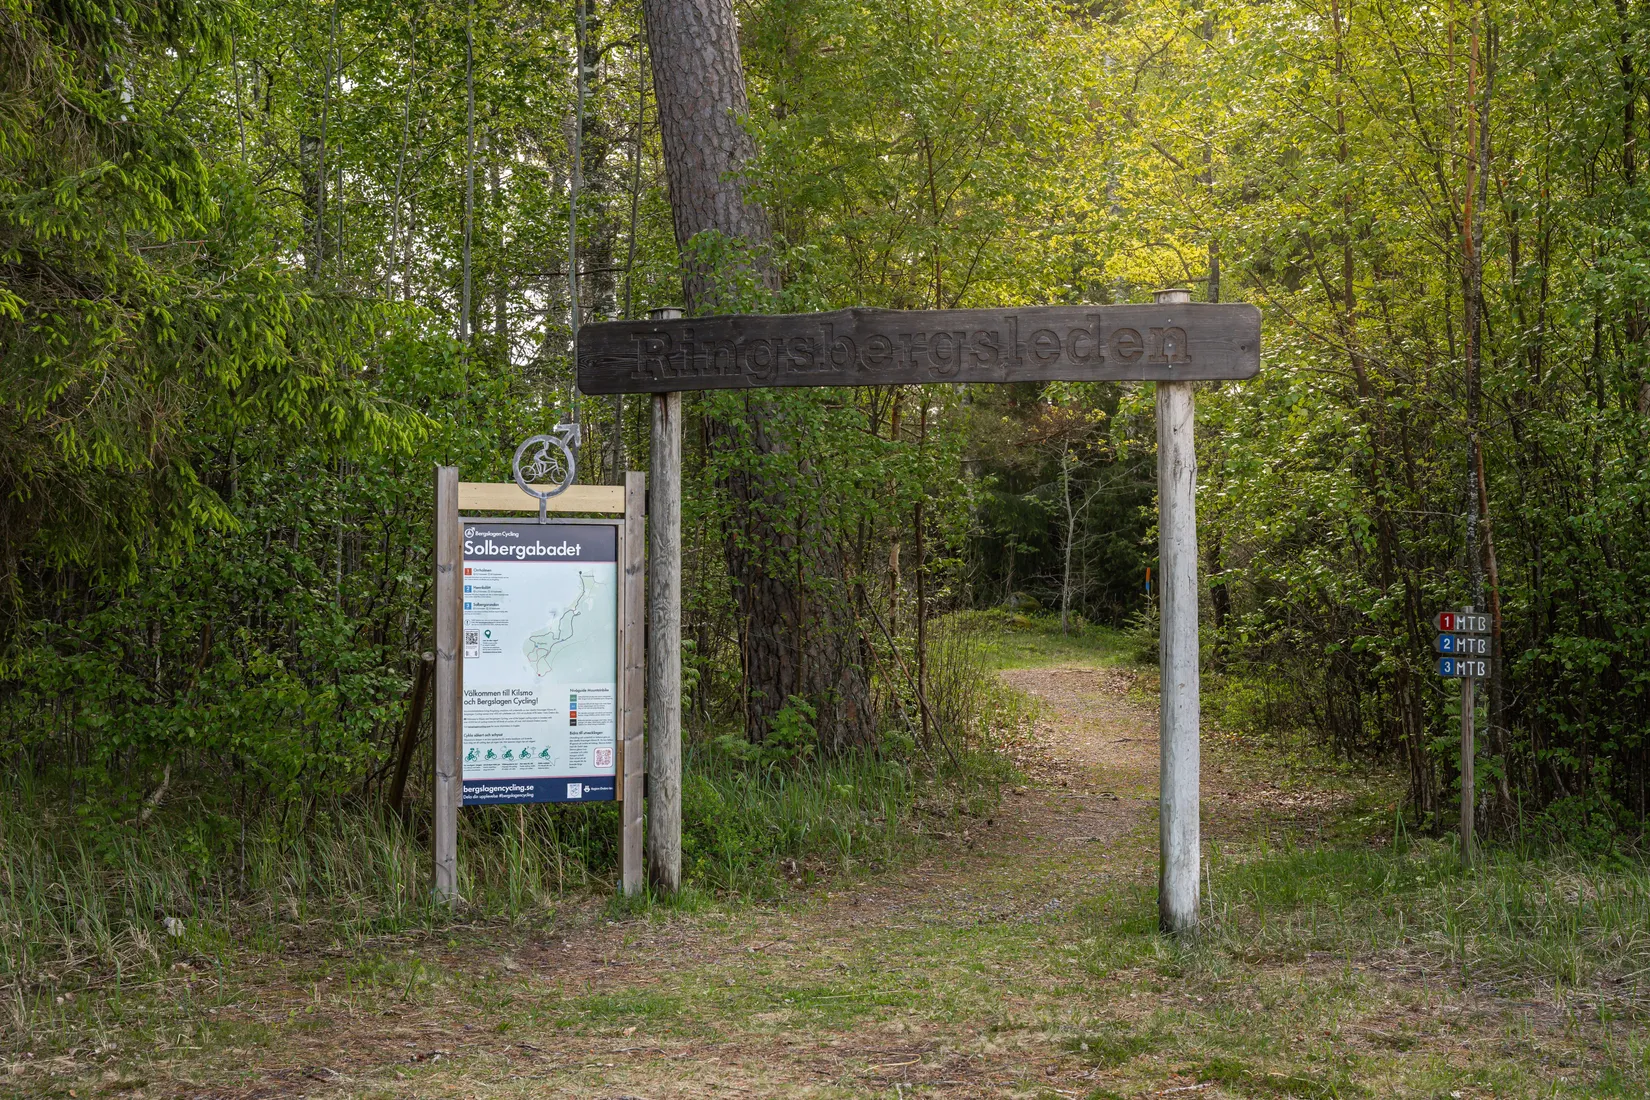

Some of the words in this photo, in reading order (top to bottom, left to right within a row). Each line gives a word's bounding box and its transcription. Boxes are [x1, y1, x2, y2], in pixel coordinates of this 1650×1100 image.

[631, 314, 1193, 384] Ringsbergsleden
[475, 530, 501, 538] Bergslagen
[502, 530, 519, 538] Cycling
[464, 540, 581, 559] Solbergabadet
[1444, 616, 1450, 628] 1
[1456, 616, 1486, 631] MTB
[1443, 638, 1451, 650] 2
[1456, 638, 1486, 653] MTB
[1444, 661, 1451, 673] 3
[1456, 661, 1485, 676] MTB
[477, 698, 512, 706] Bergslagen
[513, 697, 538, 706] Cycling!
[463, 783, 534, 794] bergslagencycling.se
